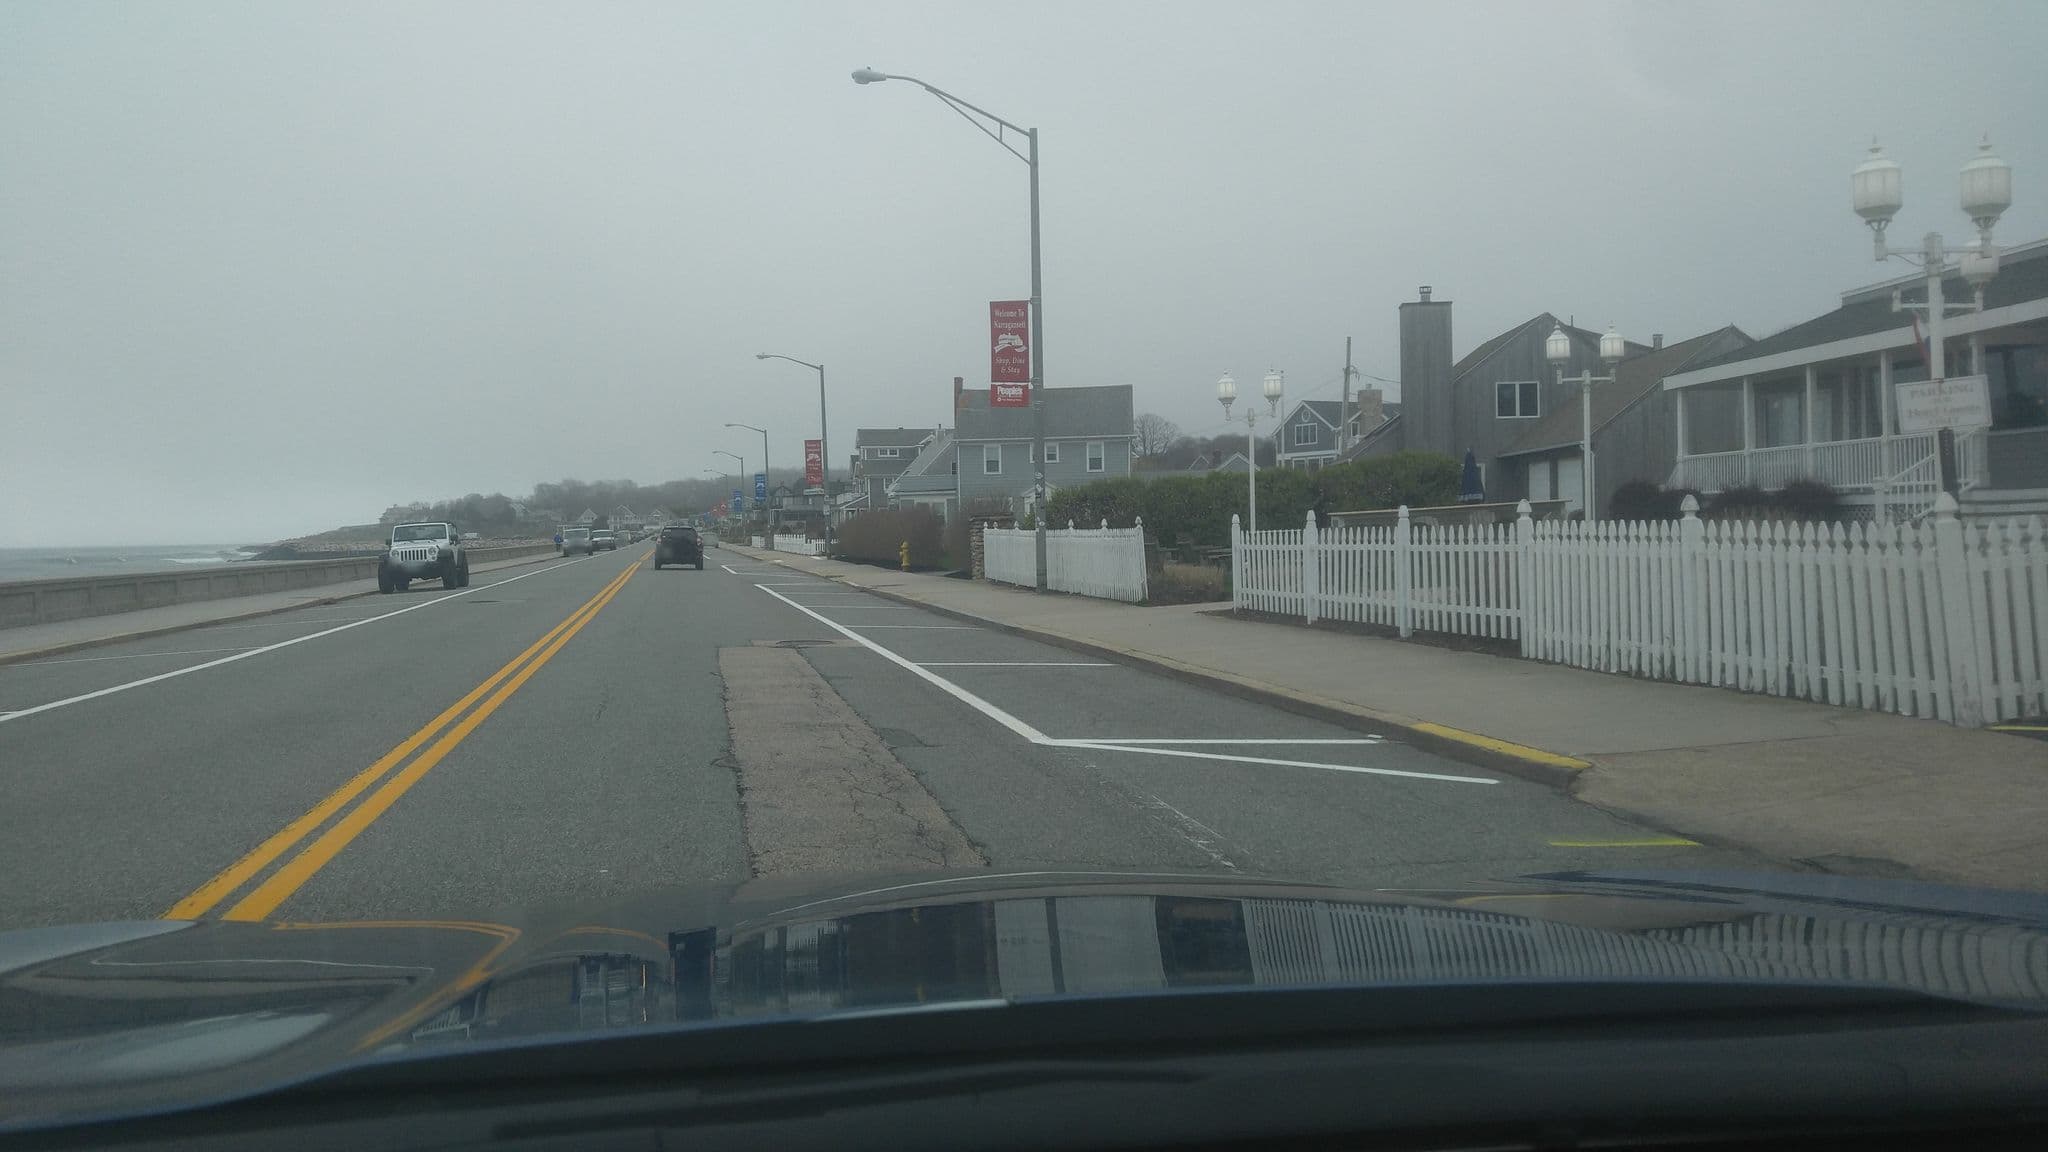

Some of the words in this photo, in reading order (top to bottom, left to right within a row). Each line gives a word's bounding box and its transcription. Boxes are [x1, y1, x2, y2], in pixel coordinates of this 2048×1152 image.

[995, 309, 1016, 318] Welcome
[1018, 309, 1024, 317] To
[994, 319, 1026, 330] Narragansett
[1012, 357, 1025, 365] Dine
[1007, 366, 1020, 374] Stay
[1910, 383, 1975, 398] PARKING
